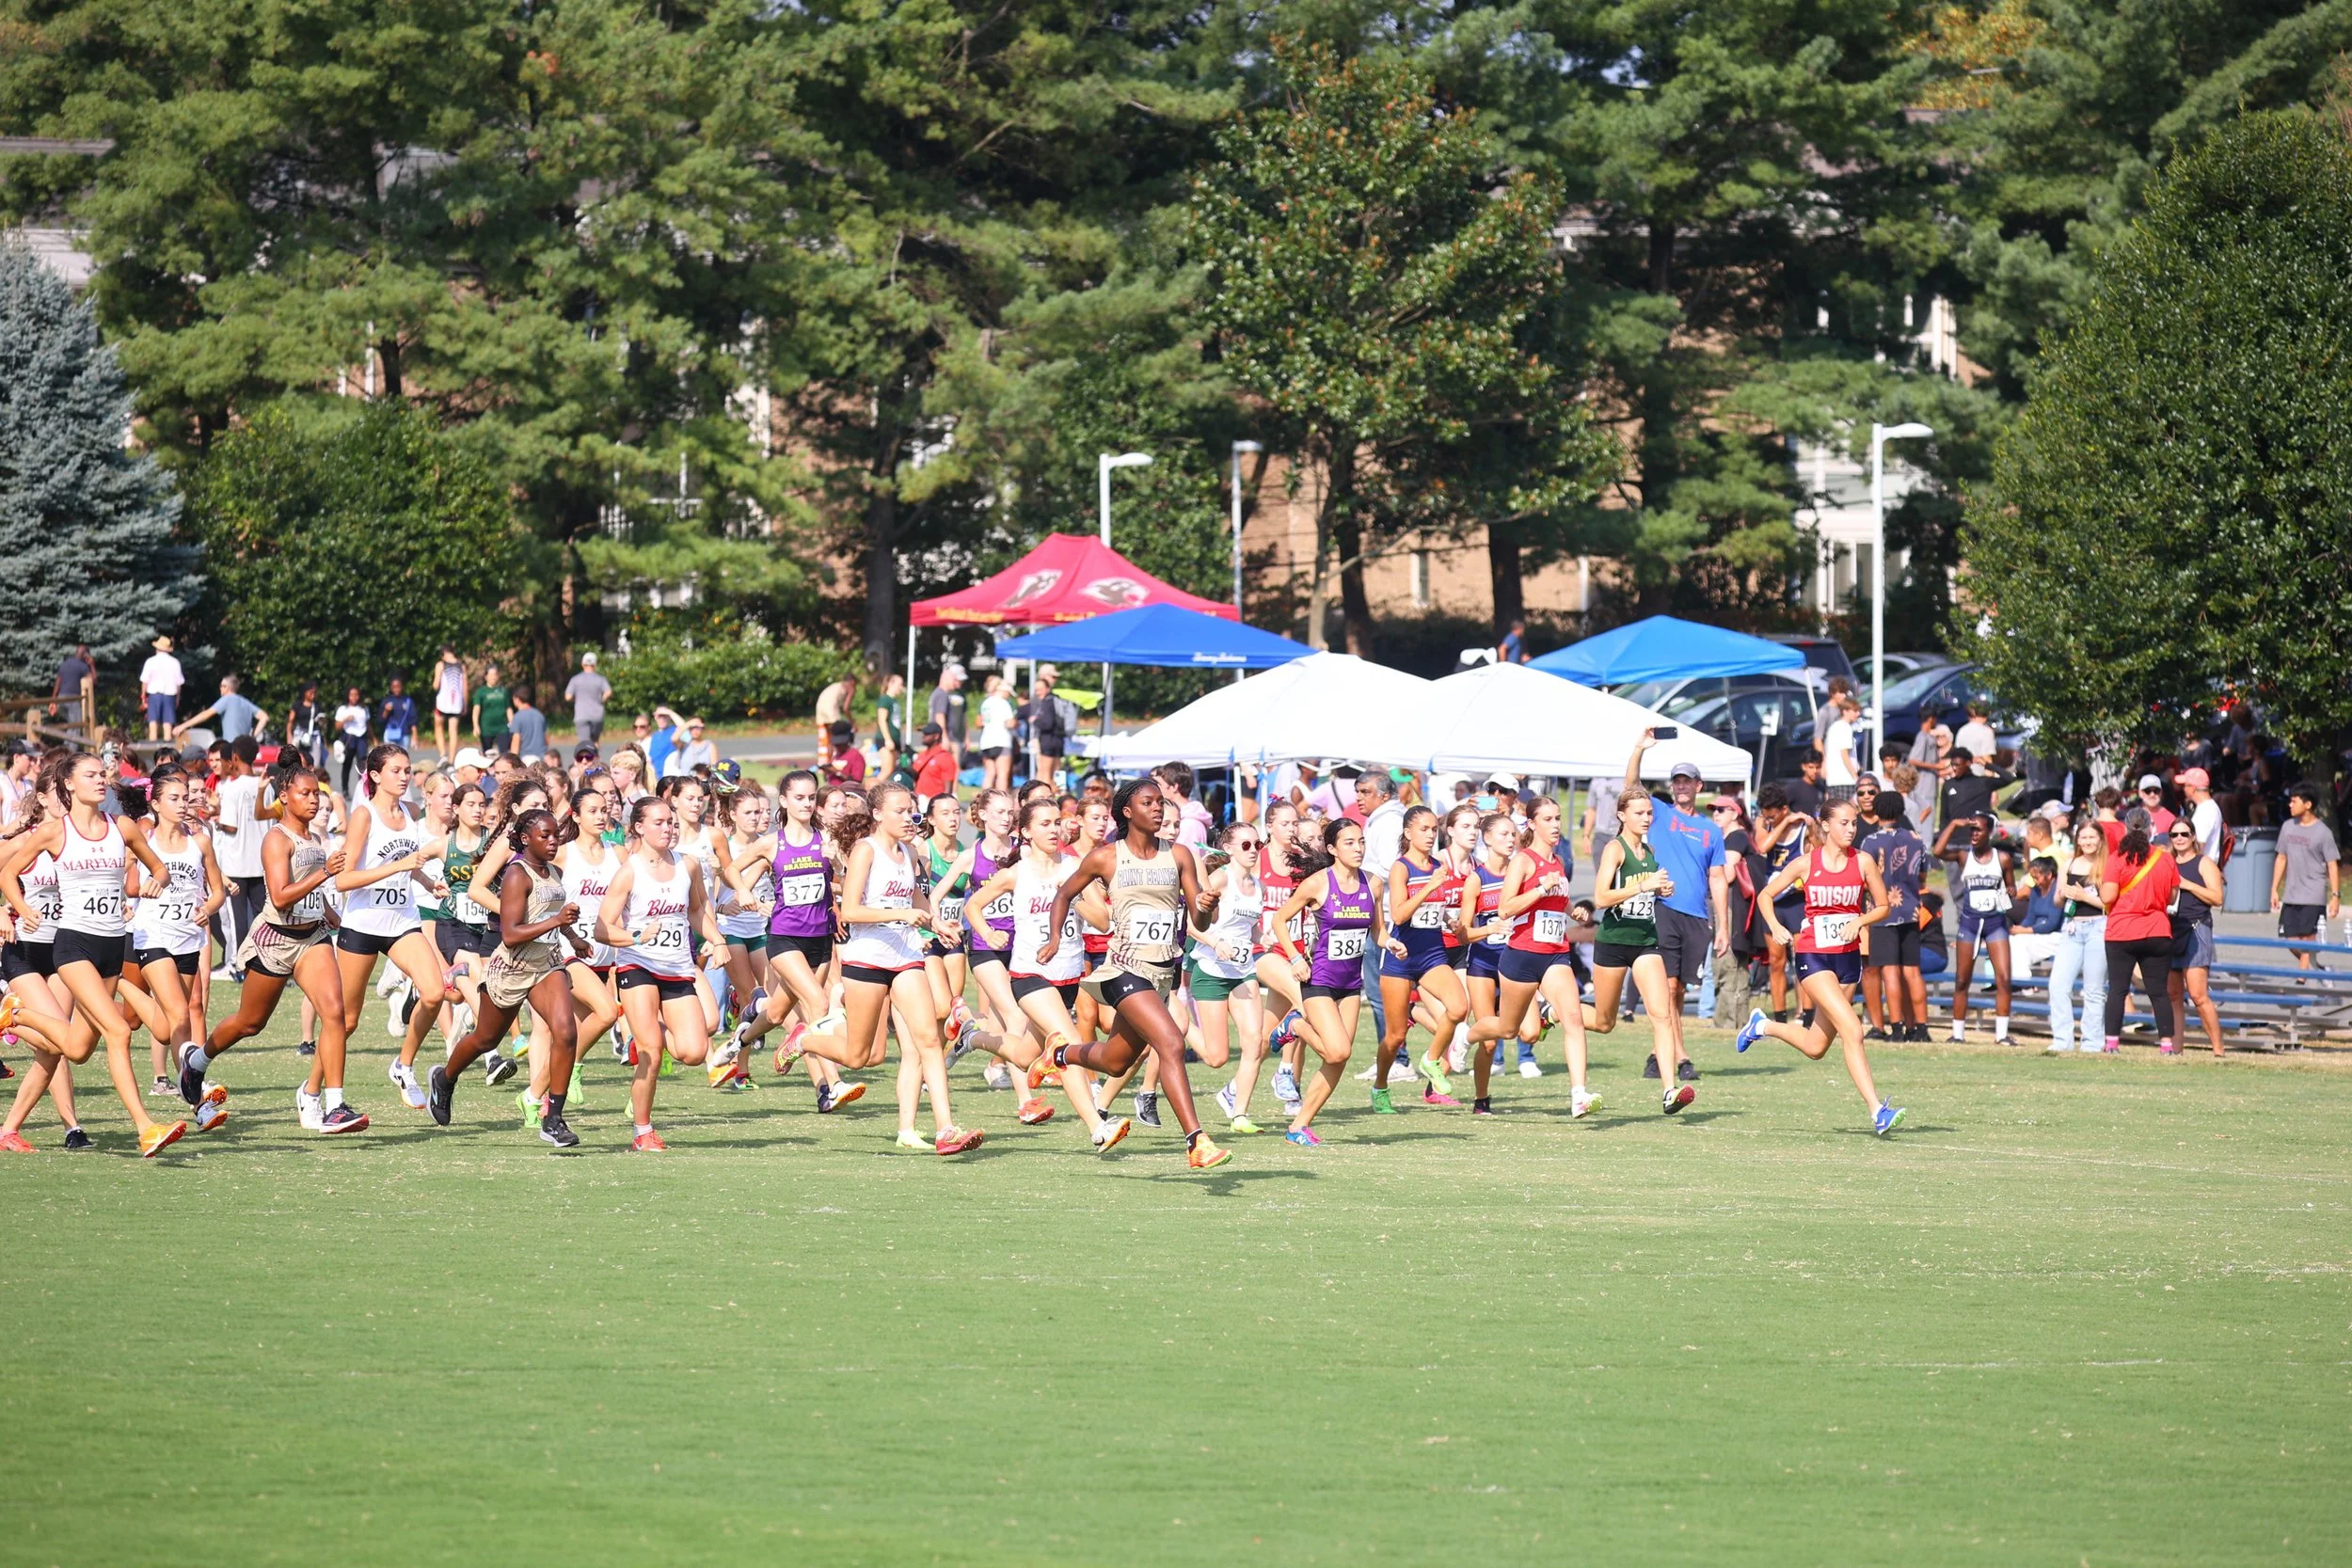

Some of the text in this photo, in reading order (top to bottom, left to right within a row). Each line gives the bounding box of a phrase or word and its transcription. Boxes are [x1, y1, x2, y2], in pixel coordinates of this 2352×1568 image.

[374, 888, 406, 905] 705
[788, 884, 822, 901] 377
[1808, 886, 1862, 907] EDISON
[83, 896, 119, 915] 467
[159, 903, 194, 921] 737
[647, 899, 686, 917] Blair
[1628, 901, 1654, 916] 123
[1420, 911, 1440, 927] 43
[1040, 920, 1074, 942] 56
[1136, 921, 1172, 942] 767
[1333, 939, 1362, 957] 381
